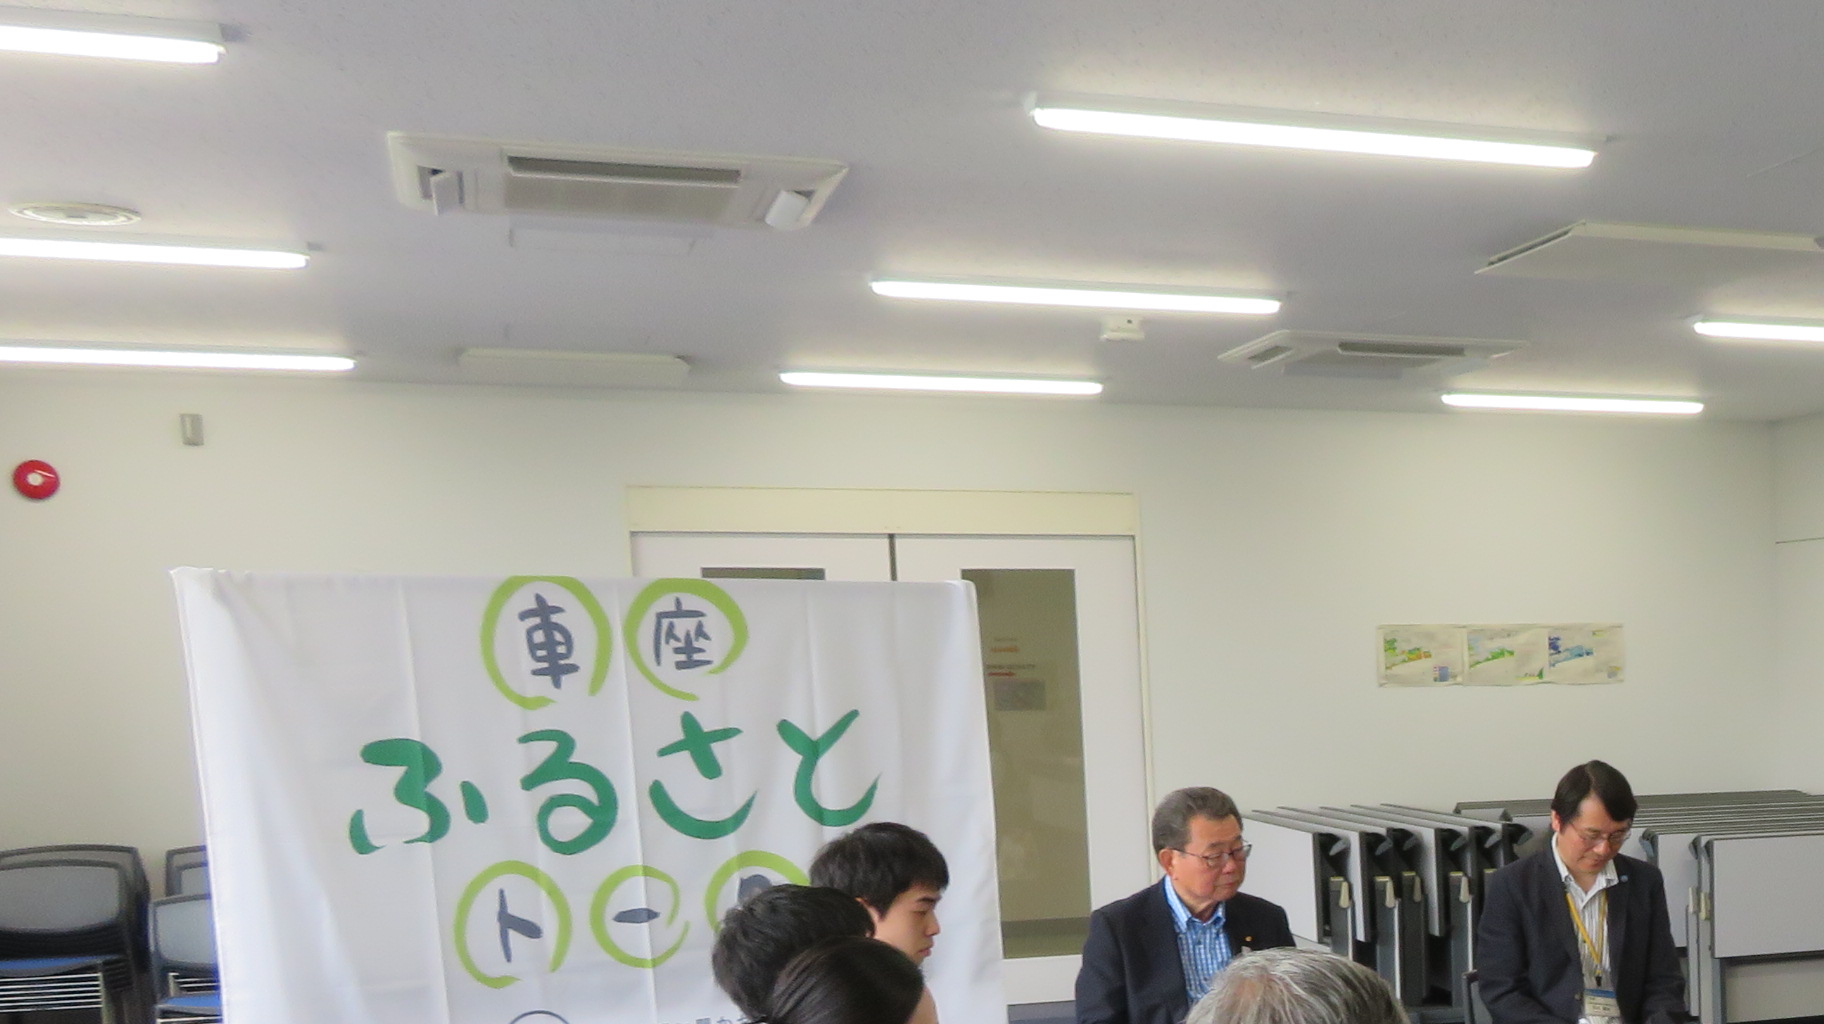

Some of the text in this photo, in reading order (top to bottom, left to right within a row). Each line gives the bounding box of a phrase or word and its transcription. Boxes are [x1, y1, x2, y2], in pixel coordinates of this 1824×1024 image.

[517, 592, 714, 691] 車座
[349, 708, 883, 856] ふるさと
